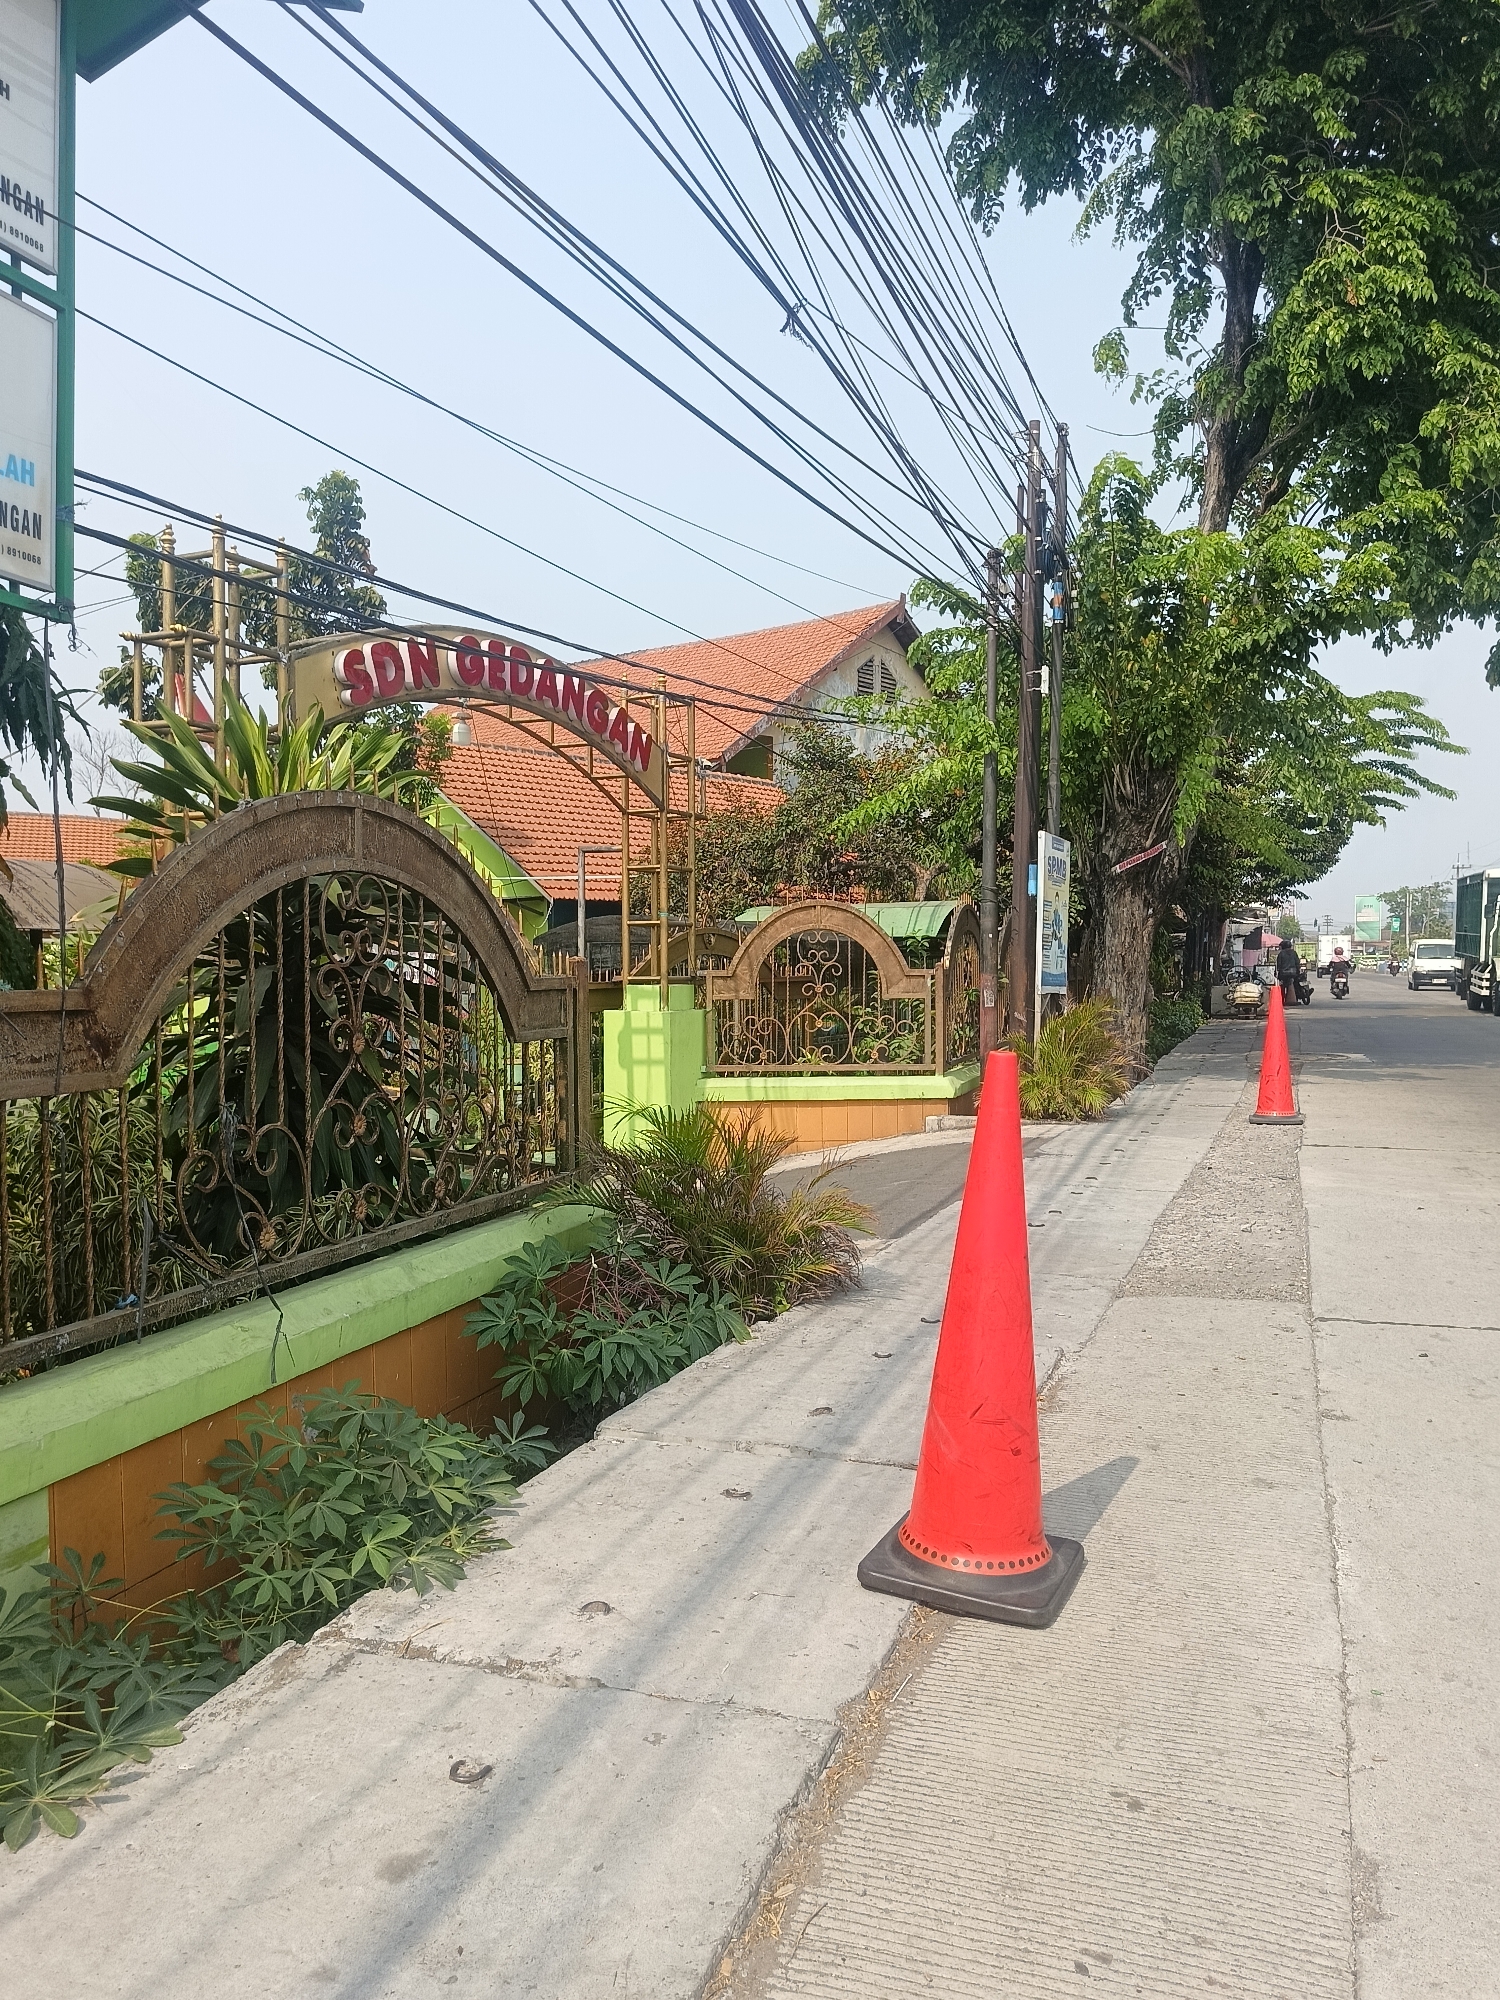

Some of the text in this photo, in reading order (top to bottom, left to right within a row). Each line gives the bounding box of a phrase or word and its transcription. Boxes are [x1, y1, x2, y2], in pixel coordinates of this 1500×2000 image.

[9, 225, 44, 253] 8910068
[7, 546, 42, 565] 8910068
[333, 634, 653, 773] SDN GEDANGAN
[1047, 855, 1067, 879] SPMB
